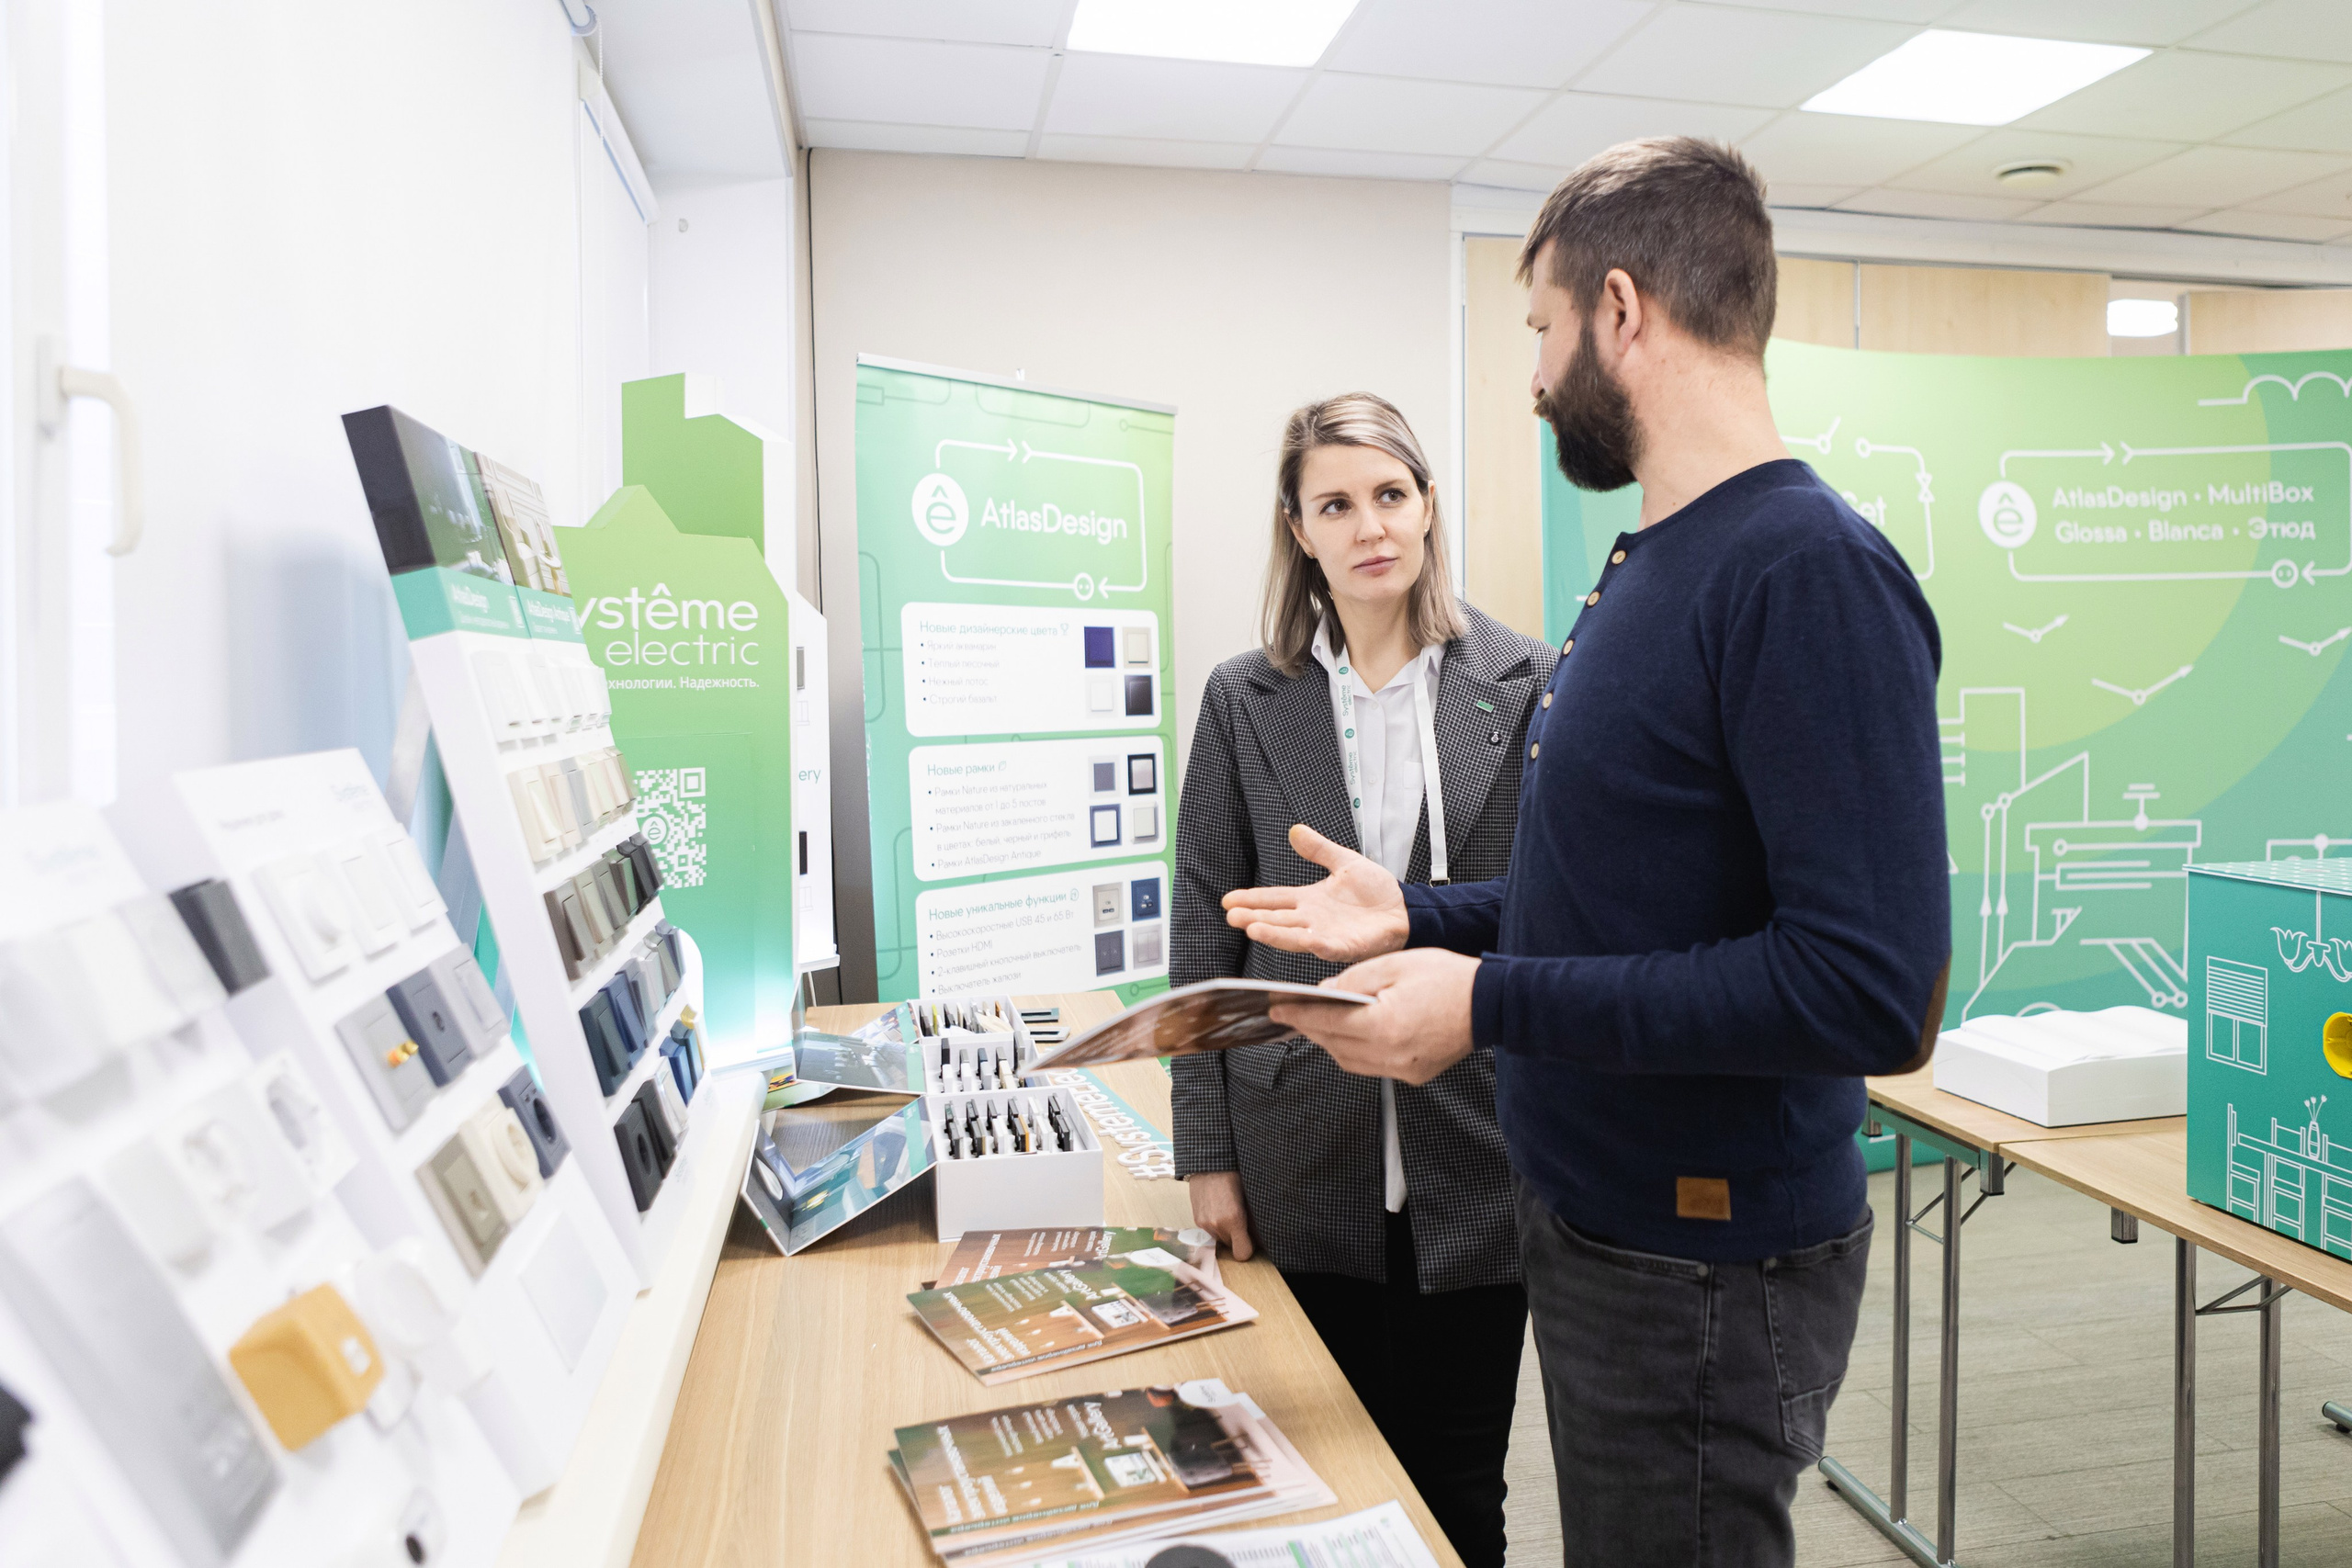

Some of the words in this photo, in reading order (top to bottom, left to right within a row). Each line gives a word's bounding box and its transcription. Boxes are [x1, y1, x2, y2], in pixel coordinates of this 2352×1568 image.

[2052, 485, 2188, 512] AtlasDesign
[2208, 480, 2314, 505] MultiBox
[980, 497, 1128, 545] AtlasDesign
[2055, 521, 2128, 544] Glossa
[2148, 519, 2223, 542] Blanca
[2248, 516, 2315, 542] Этюд
[920, 621, 956, 633] Новые
[959, 623, 1028, 637] дизайнерские
[1030, 626, 1057, 637] цвета
[605, 631, 759, 666] electric
[926, 640, 954, 651] Яркий
[606, 679, 676, 689] хнологии.
[680, 676, 760, 691] Надежность.
[928, 676, 963, 686] Нежный
[930, 694, 966, 705] Строгий
[967, 694, 997, 704] базальт
[927, 764, 963, 776] Новые
[966, 763, 995, 777] рамки
[934, 786, 961, 796] Рамки
[962, 784, 988, 795] Nature
[1000, 782, 1047, 795] натуральных
[935, 804, 983, 816] материалов
[984, 802, 993, 811] от
[1000, 801, 1011, 810] до
[1012, 798, 1018, 808] 5
[1019, 798, 1046, 807] постов
[936, 822, 962, 833] Рамки
[963, 820, 989, 831] Nature
[1001, 816, 1048, 827] закаленного
[1050, 813, 1075, 822] стекла
[1003, 832, 1032, 845] черный
[1040, 829, 1072, 841] грифель
[937, 859, 963, 869] Рамки
[965, 853, 1010, 866] AtlasDesign
[1011, 849, 1041, 860] Antique
[929, 908, 964, 921] Новые
[966, 898, 1023, 918] уникальные
[1025, 892, 1067, 908] функции
[936, 920, 1014, 941] Высокоскоростные
[1015, 915, 1033, 928] USB
[1035, 914, 1045, 924] 45
[1053, 911, 1064, 920] 65
[1065, 909, 1074, 919] Вт
[936, 947, 970, 959] Розетки
[971, 940, 993, 953] HDMI
[937, 958, 989, 977] 2-клавишный
[990, 952, 1032, 966] кнопочный
[1033, 942, 1082, 959] выключатель
[938, 976, 991, 996] Выключатель
[992, 970, 1022, 985] жалюзи
[1057, 1269, 1102, 1301] ArtGallery
[1084, 1401, 1123, 1450] ArtGallery
